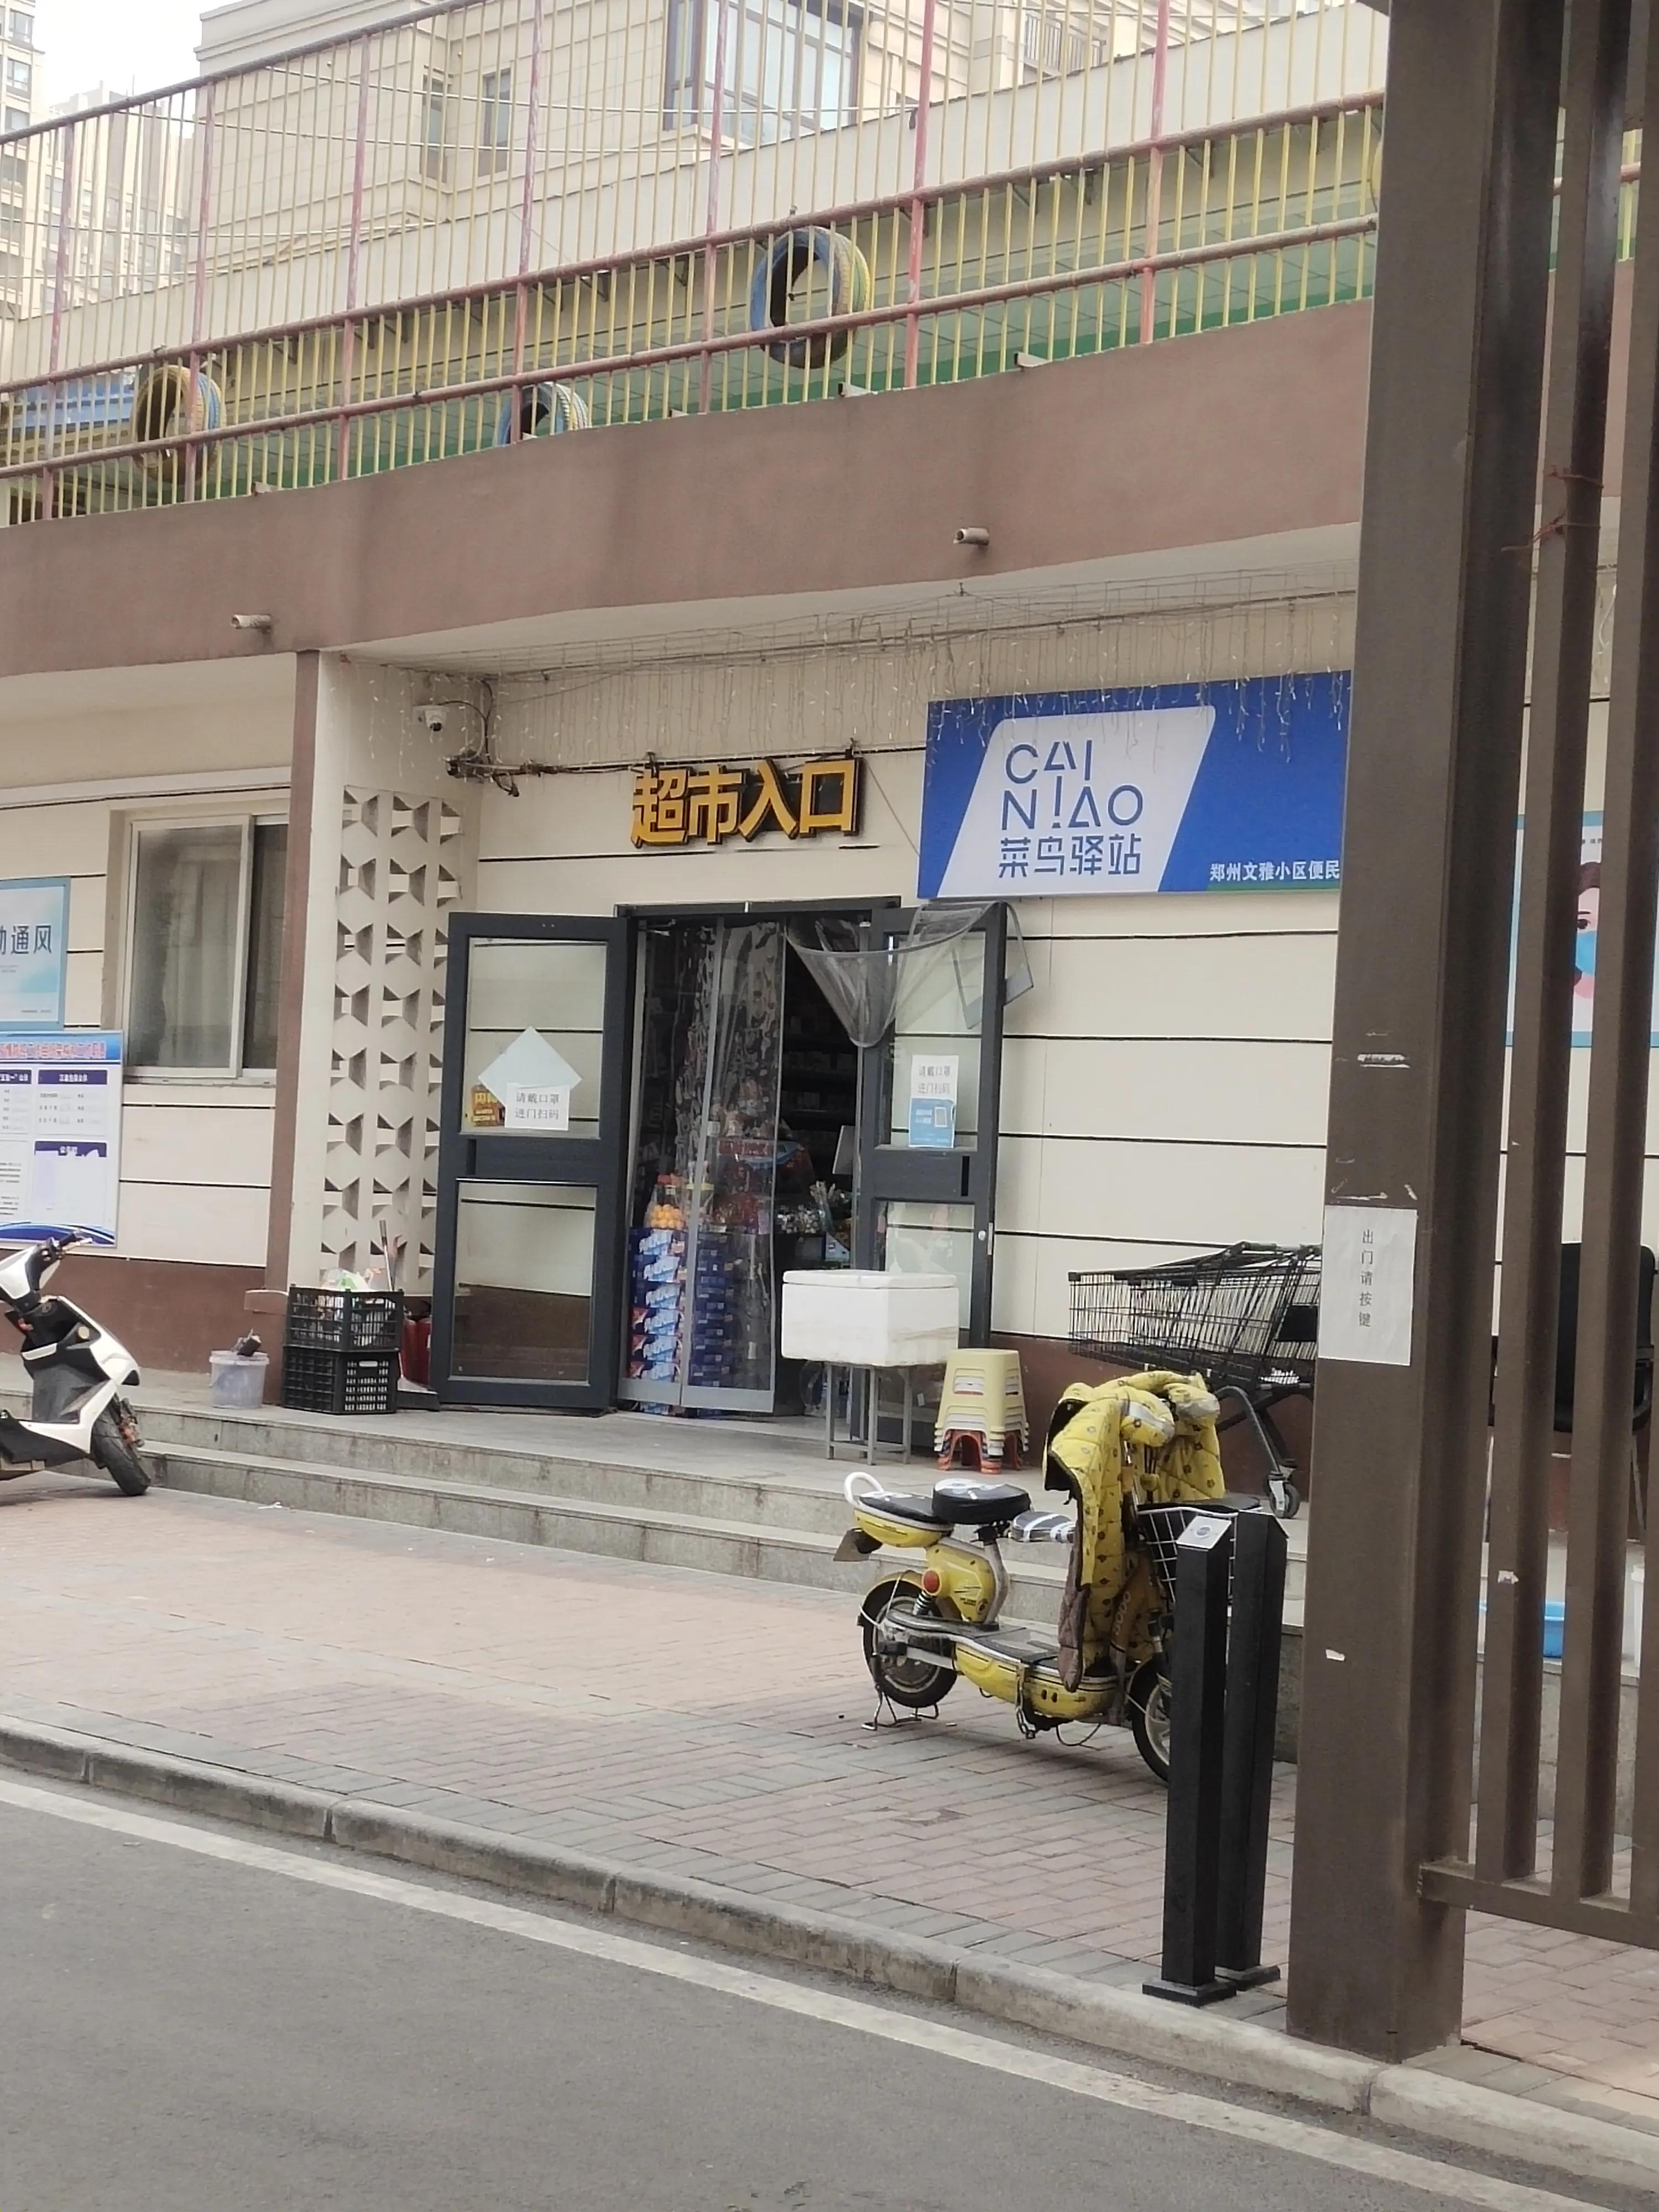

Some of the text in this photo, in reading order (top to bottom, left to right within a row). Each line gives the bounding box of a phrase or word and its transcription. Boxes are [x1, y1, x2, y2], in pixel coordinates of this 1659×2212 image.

[1004, 739, 1092, 784] CAI
[631, 758, 863, 847] 超市入口
[1001, 776, 1144, 830] NIAO
[999, 833, 1142, 878] 菜鸟驿站
[1209, 860, 1340, 881] 郑州文雅小区便民
[1358, 1229, 1374, 1327] 出门请按键
